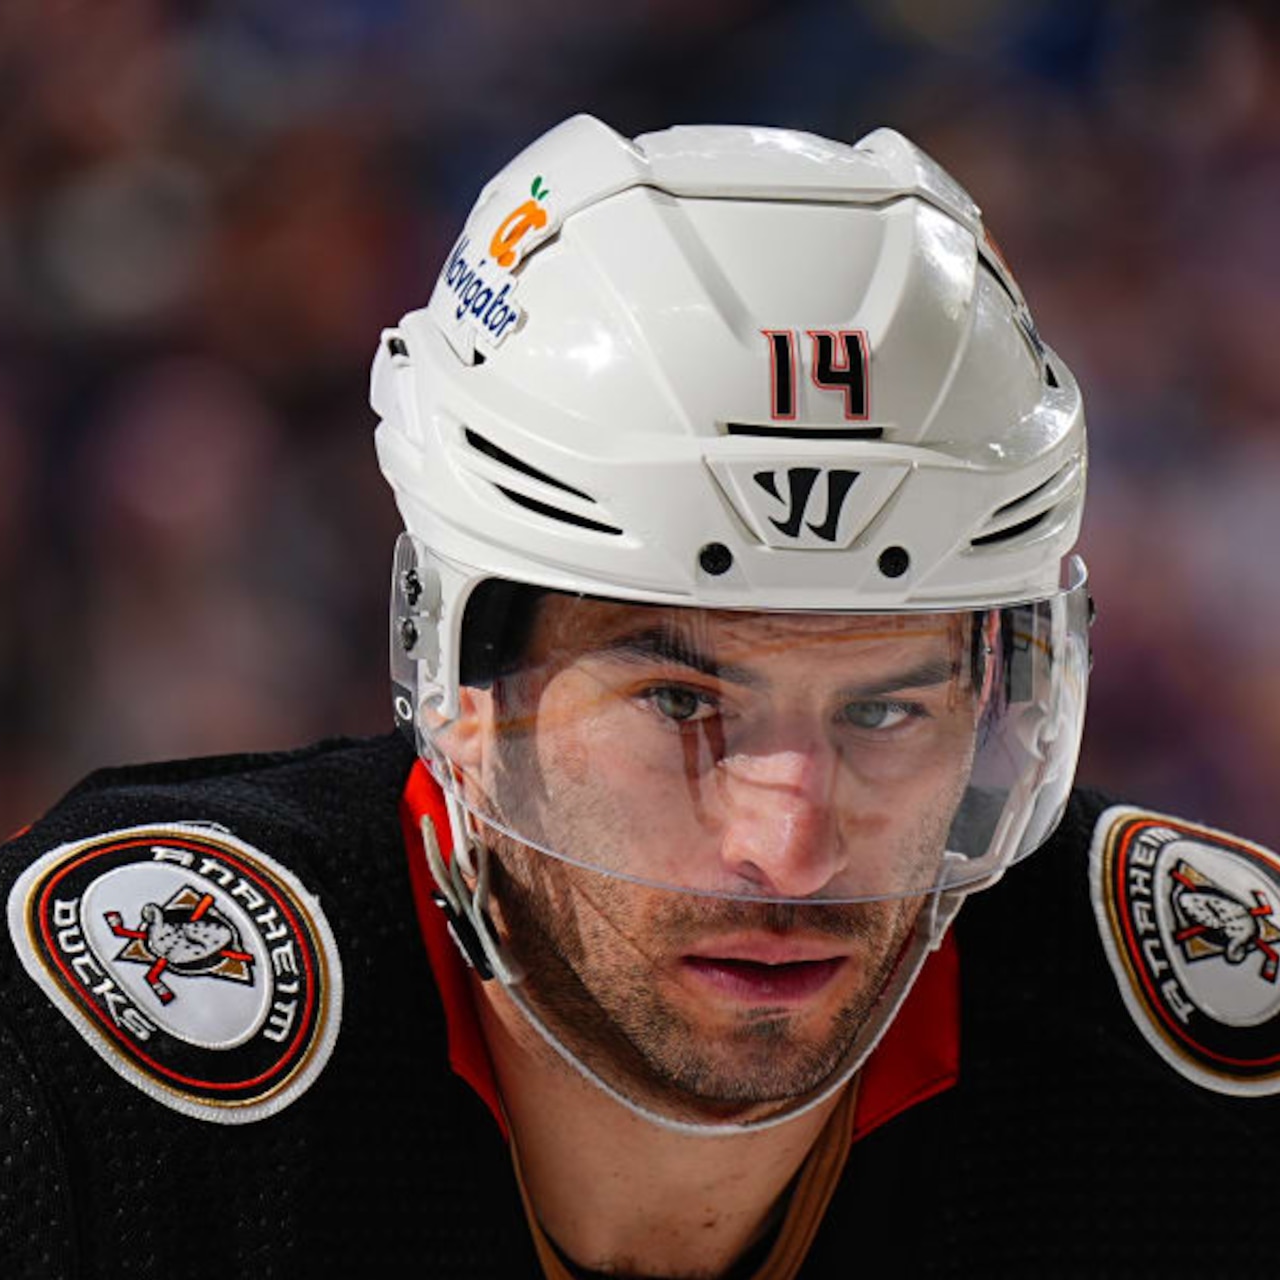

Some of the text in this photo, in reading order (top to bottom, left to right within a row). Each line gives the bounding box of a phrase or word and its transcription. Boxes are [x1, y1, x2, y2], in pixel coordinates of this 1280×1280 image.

[761, 329, 869, 420] 14
[54, 899, 161, 1042] DUCKS
[150, 846, 300, 1043] ANAHEIM
[1130, 826, 1194, 1024] ANAHEIM
